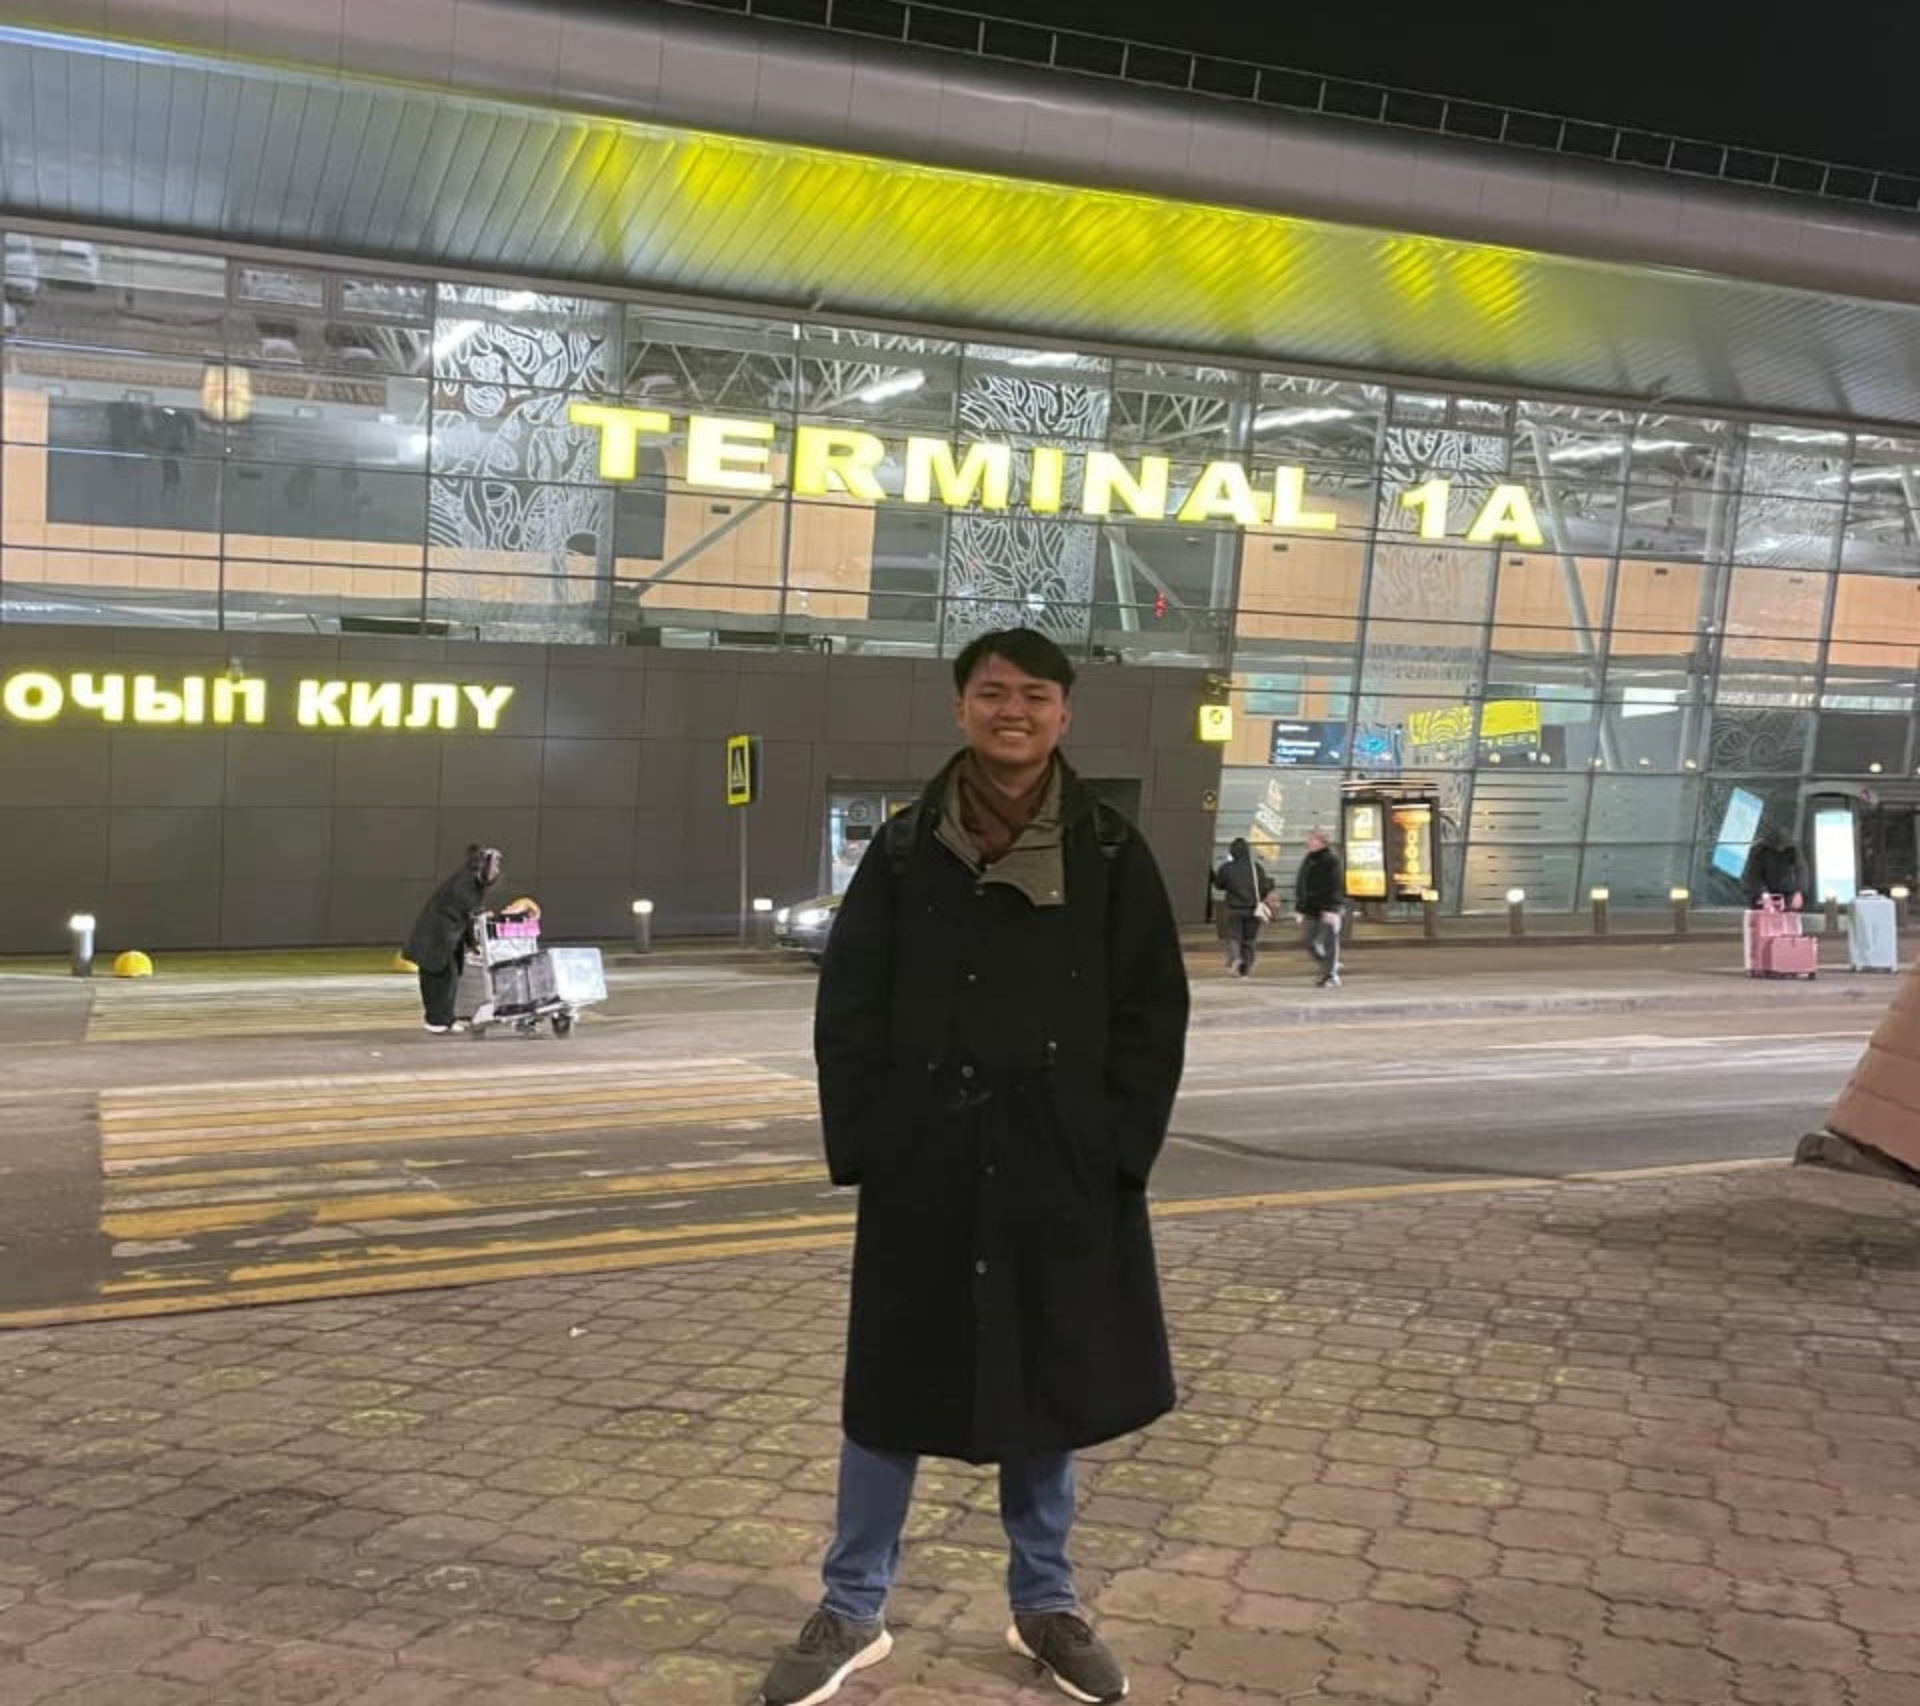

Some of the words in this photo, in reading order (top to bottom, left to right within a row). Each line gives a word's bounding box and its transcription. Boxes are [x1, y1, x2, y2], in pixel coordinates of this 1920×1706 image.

[568, 403, 1337, 531] TERMINAL
[1400, 479, 1545, 545] 1A
[3, 671, 266, 723] ОЧЫП
